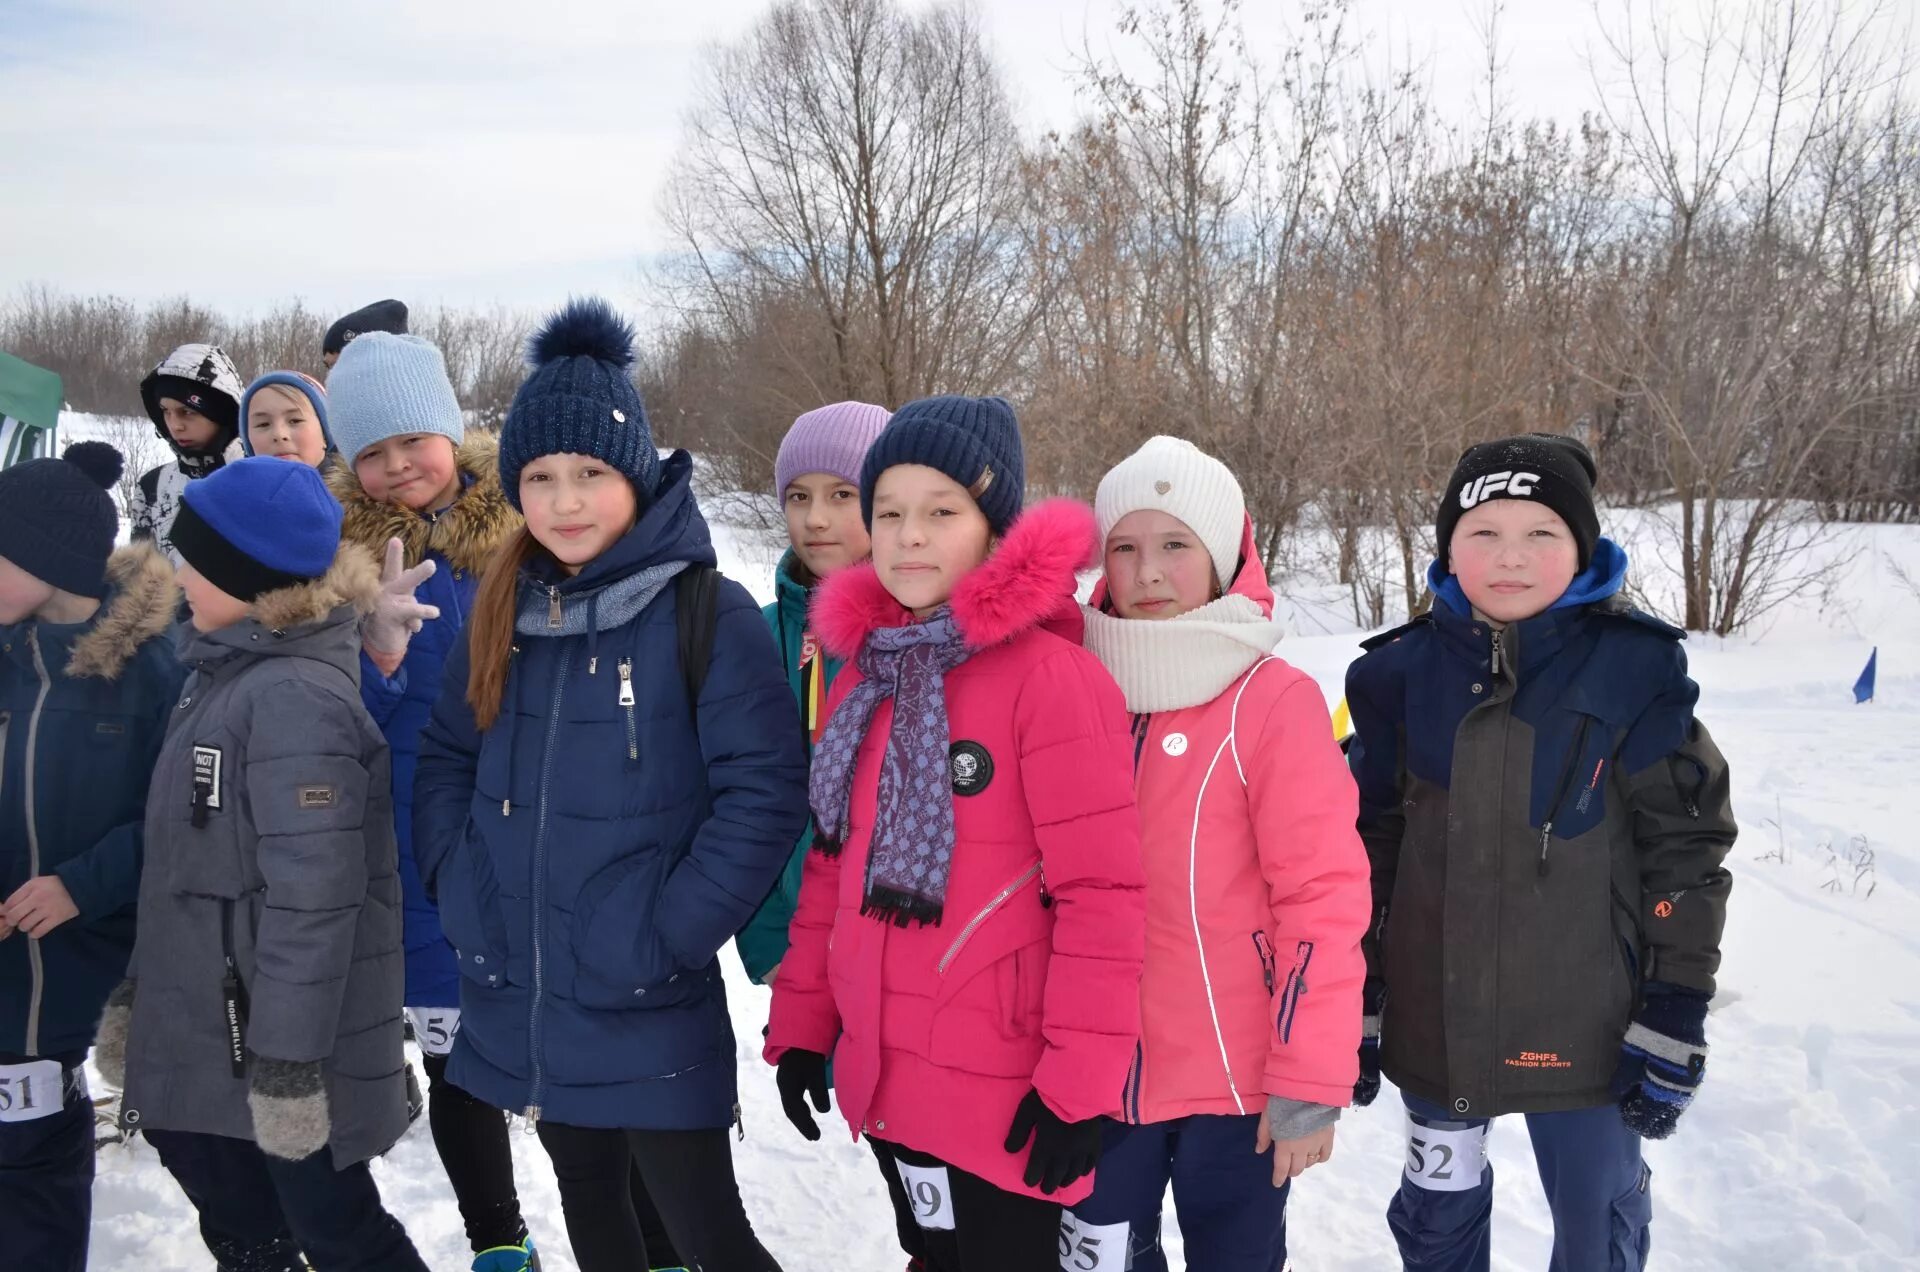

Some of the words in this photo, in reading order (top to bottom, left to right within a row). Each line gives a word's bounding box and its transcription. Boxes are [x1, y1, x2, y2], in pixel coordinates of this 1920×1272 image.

[1459, 470, 1541, 509] UFC
[196, 753, 214, 767] NOT
[1504, 1058, 1539, 1068] FASHION
[1520, 1051, 1558, 1062] ZGHFS
[1407, 1135, 1454, 1180] 52
